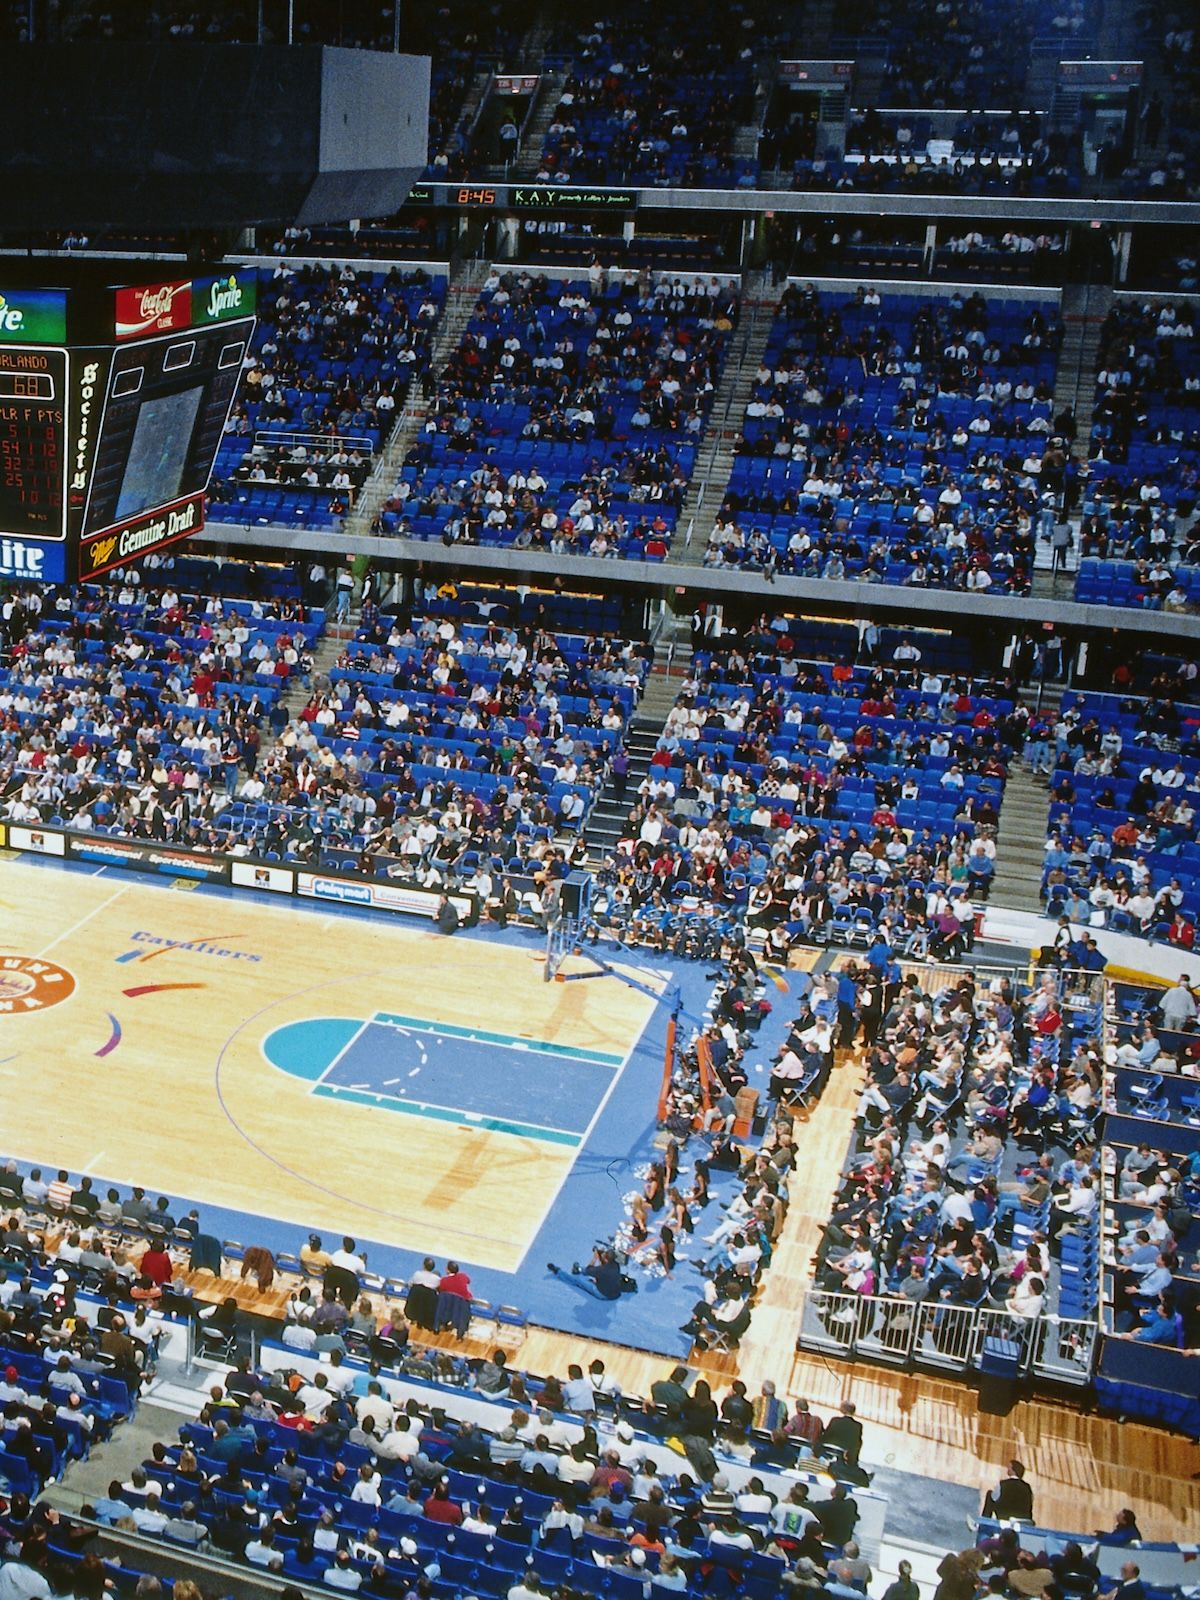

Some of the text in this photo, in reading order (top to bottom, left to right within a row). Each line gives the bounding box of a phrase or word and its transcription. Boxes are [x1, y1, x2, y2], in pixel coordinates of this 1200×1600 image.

[458, 189, 496, 204] 8:45
[515, 190, 556, 202] KAY
[207, 282, 242, 318] Sprite
[14, 375, 38, 396] 68
[24, 408, 32, 422] F
[37, 410, 63, 424] PTS
[70, 362, 99, 489] Society
[2, 440, 20, 454] 54
[4, 456, 22, 470] 32
[6, 472, 23, 487] 25
[119, 502, 195, 556] Genuine Draft
[90, 536, 118, 568] Miller
[15, 569, 44, 579] BEER
[70, 841, 144, 860] SportsChannel
[149, 854, 224, 873] SportsChannel
[345, 886, 370, 900] mart
[130, 931, 263, 962] Cavaliers
